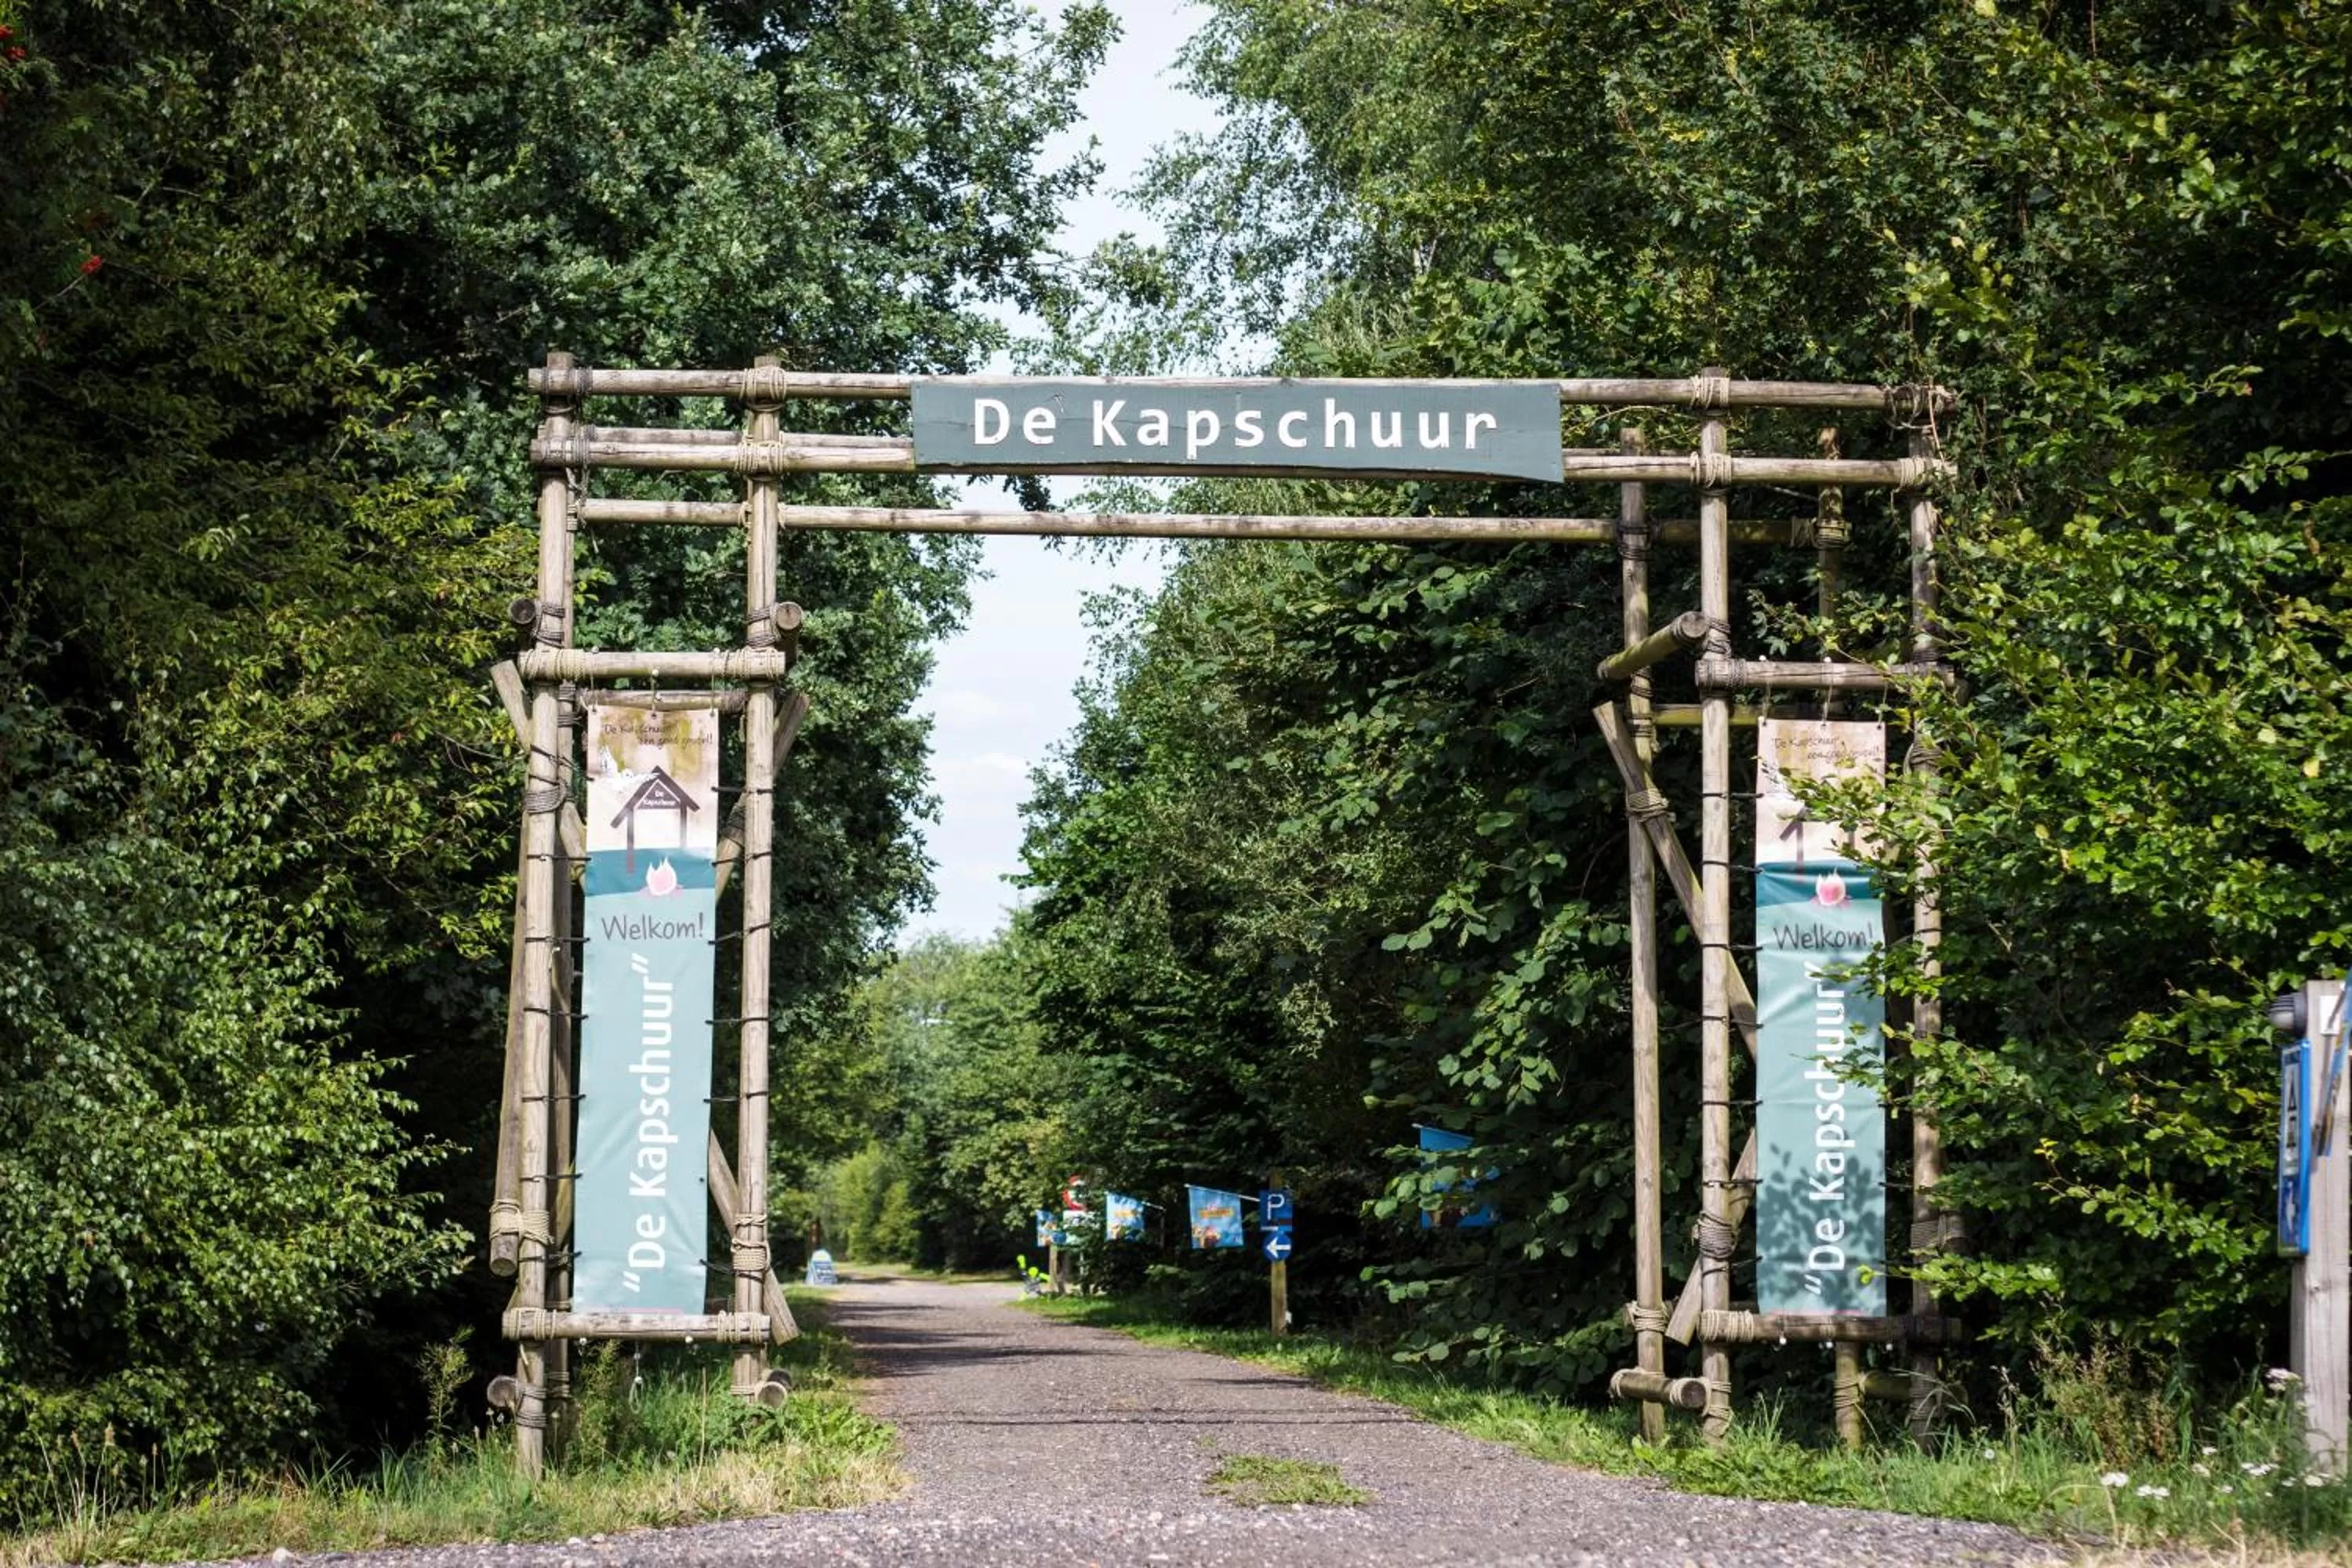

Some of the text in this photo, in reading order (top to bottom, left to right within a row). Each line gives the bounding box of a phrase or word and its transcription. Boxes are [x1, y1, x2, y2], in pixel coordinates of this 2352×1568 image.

[974, 398, 1498, 461] De Kapschuur
[601, 912, 705, 942] Welkom!
[1773, 920, 1874, 951] Welkom!
[1268, 1193, 1285, 1220] P
